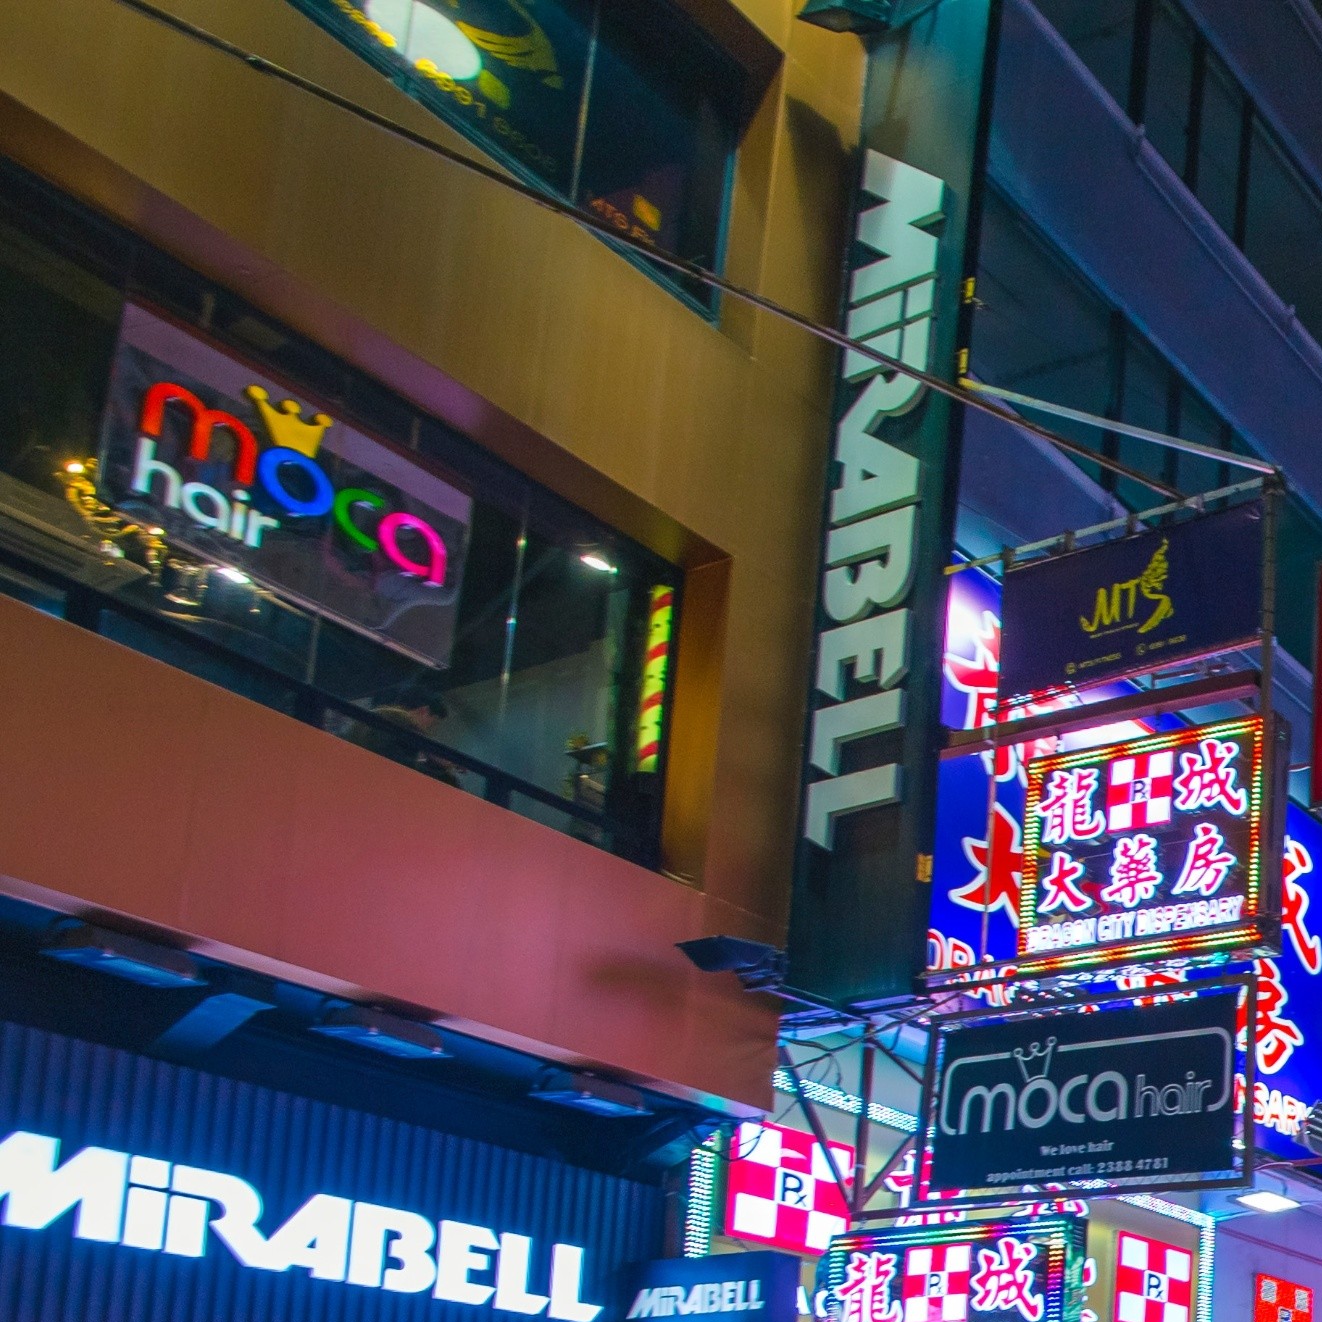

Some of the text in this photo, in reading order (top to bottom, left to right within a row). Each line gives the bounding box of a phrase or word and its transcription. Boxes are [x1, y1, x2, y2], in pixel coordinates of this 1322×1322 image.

[130, 434, 280, 550] hair
[803, 147, 947, 853] MIRABELL
[1037, 823, 1236, 914] 大藥房
[1026, 895, 1243, 952] DRAGON CITY DISPENSARY
[959, 1071, 1129, 1136] moca
[1133, 1070, 1211, 1118] hair
[986, 1164, 1066, 1183] appointment
[1040, 1139, 1114, 1157] We love hair
[627, 1279, 764, 1321] MIRABELL
